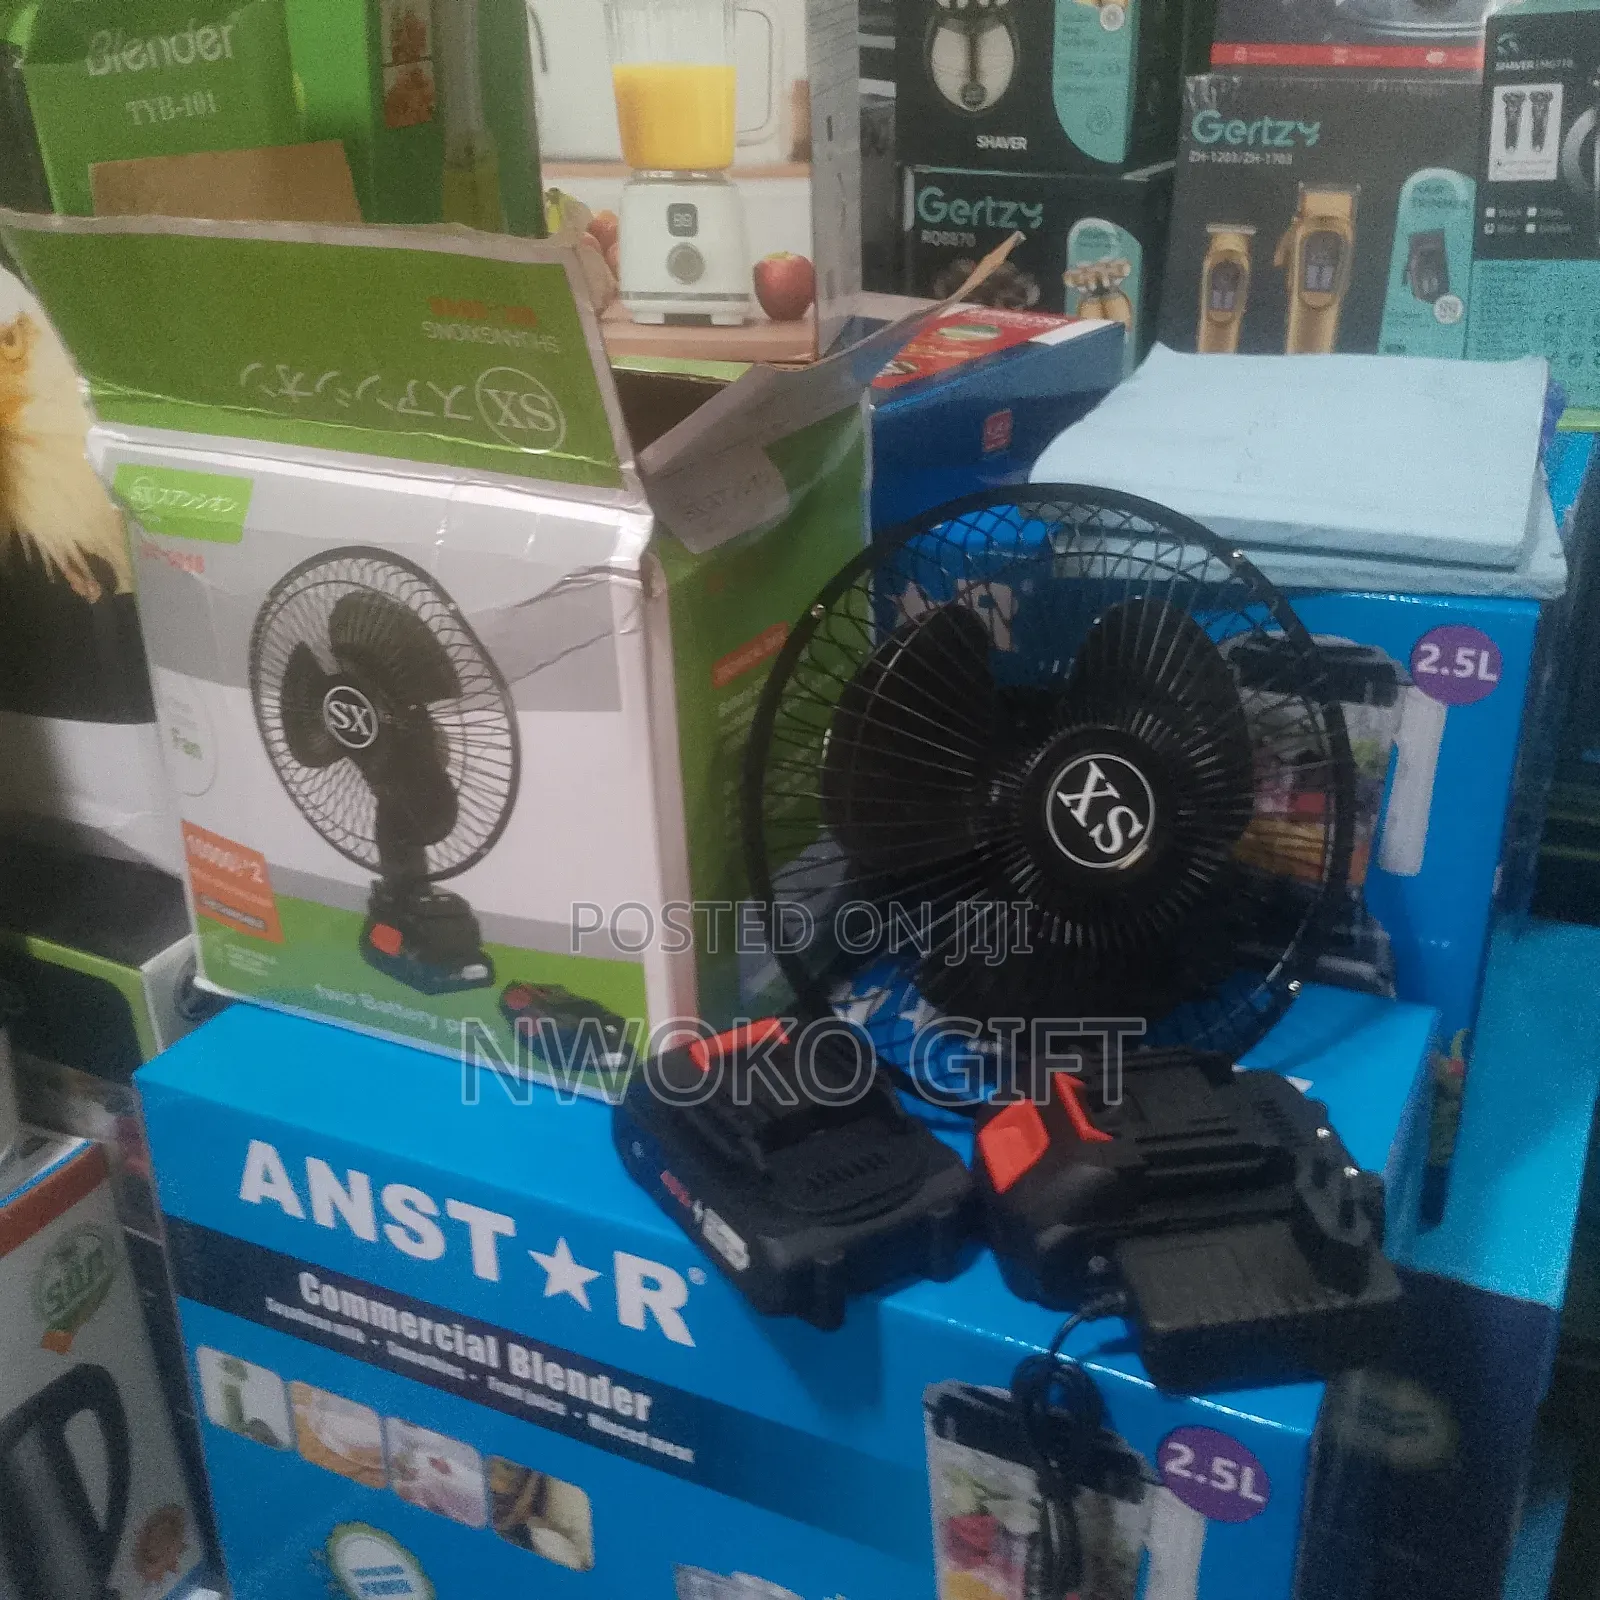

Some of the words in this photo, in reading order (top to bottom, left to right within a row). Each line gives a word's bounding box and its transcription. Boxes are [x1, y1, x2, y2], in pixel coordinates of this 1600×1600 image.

[976, 134, 1028, 151] SHAVER
[1191, 109, 1321, 147] Gertzy
[917, 186, 1043, 229] Gertzy
[1416, 643, 1499, 682] 2.5L
[330, 699, 371, 738] SX
[299, 1271, 500, 1369] Commercial
[507, 1343, 653, 1422] Blender
[1165, 1441, 1267, 1504] 2.5L
